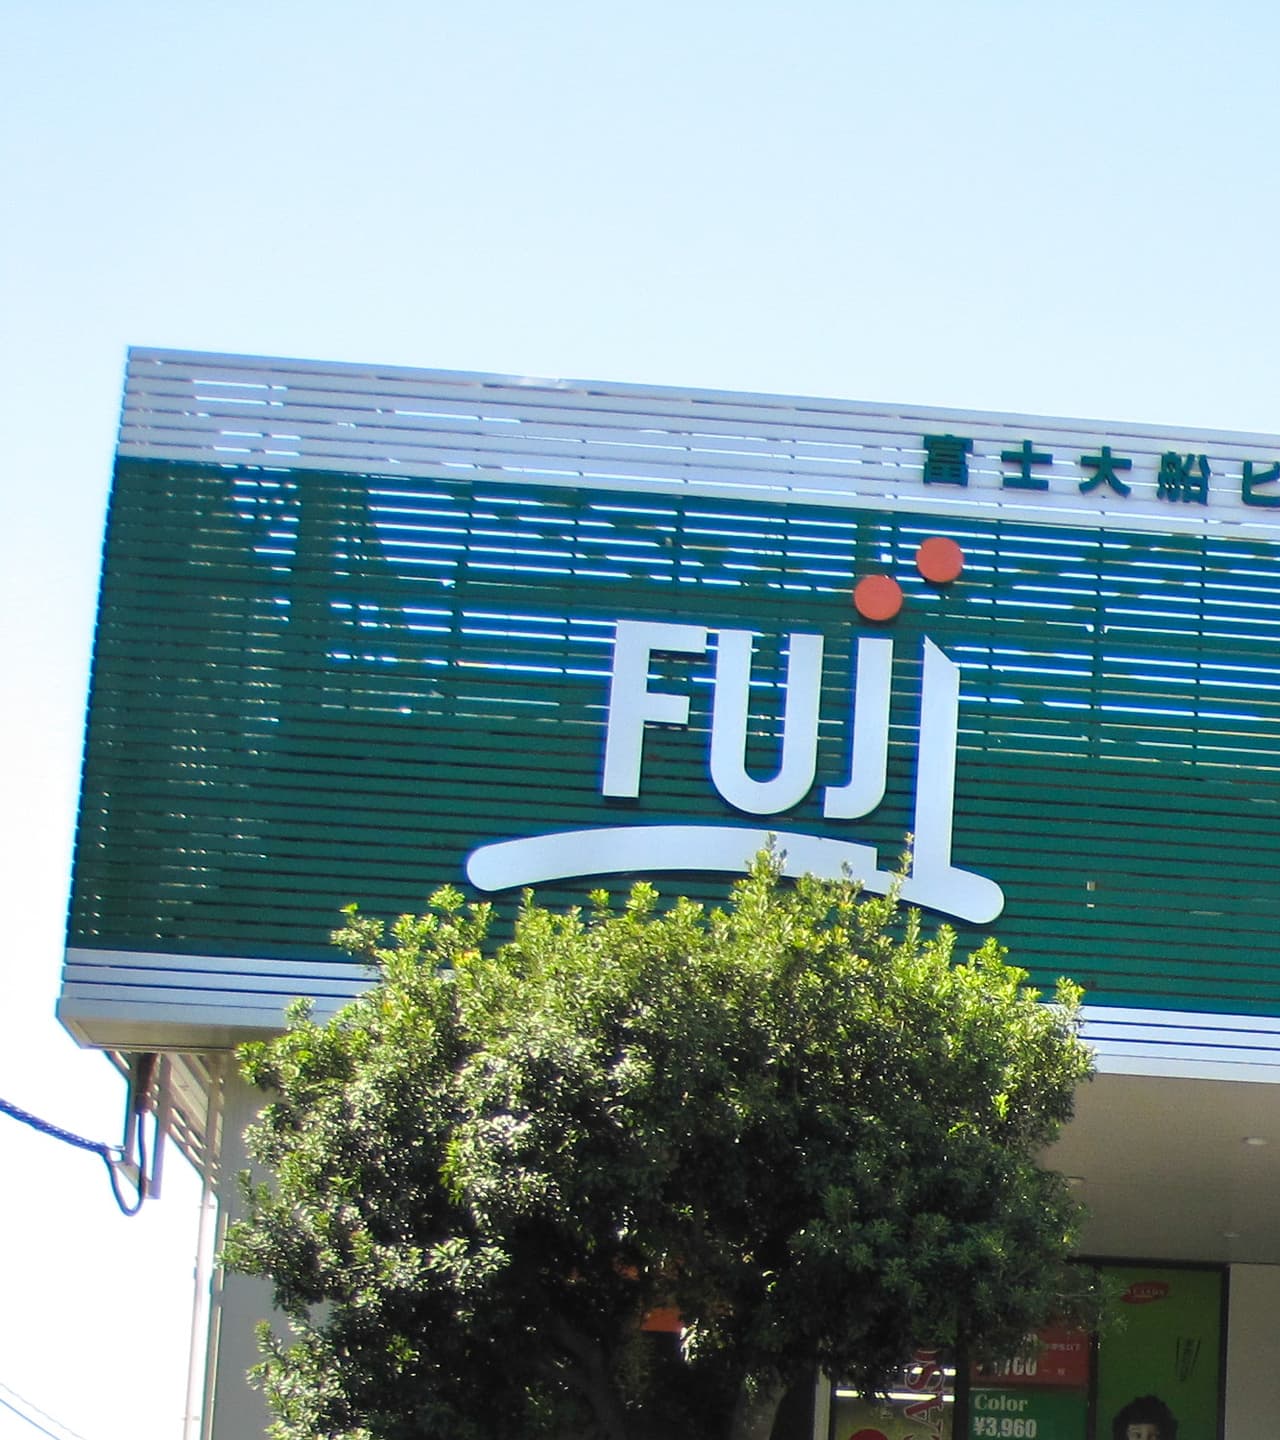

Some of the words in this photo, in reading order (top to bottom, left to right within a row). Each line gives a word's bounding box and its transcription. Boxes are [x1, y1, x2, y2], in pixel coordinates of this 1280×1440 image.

[601, 538, 965, 880] FUJI
[973, 1393, 1029, 1413] Color
[973, 1417, 1038, 1440] ¥3,960
